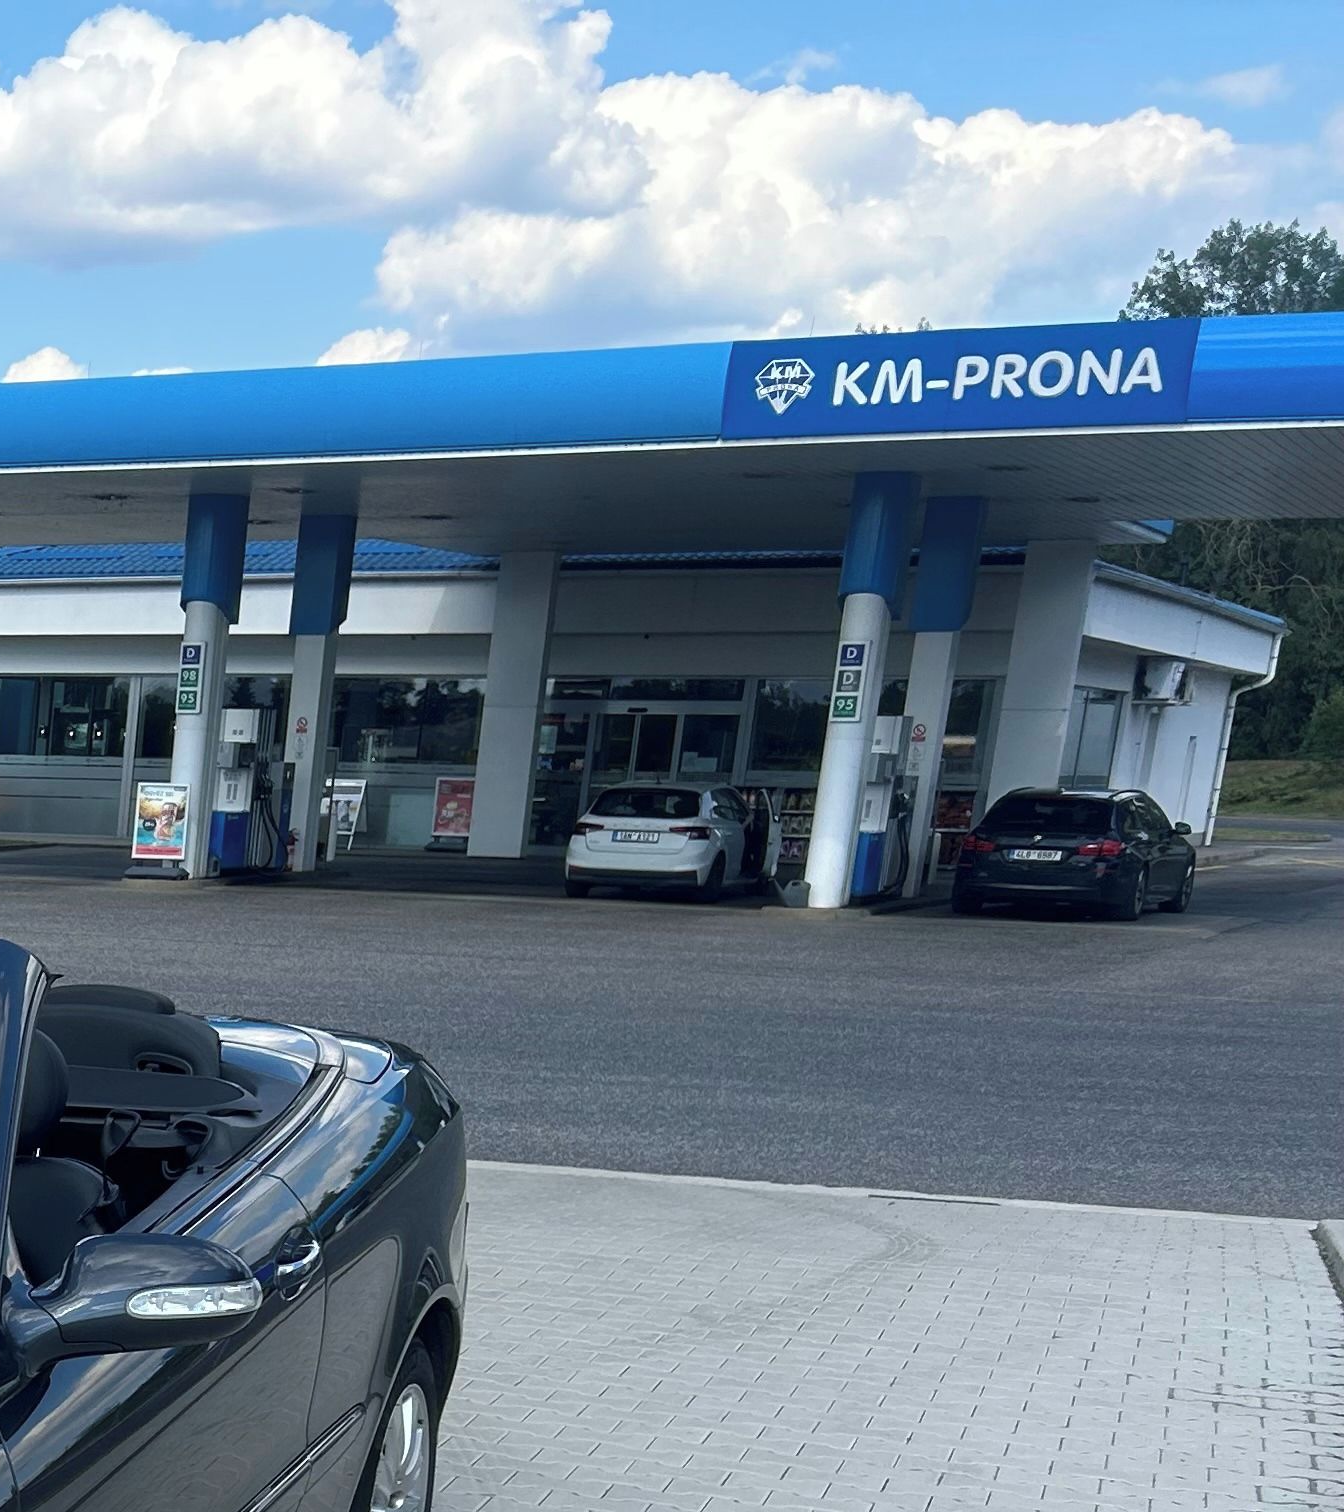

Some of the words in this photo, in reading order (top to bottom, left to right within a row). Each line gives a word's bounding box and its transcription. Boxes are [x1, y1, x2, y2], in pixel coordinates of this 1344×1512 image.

[770, 366, 802, 379] KM
[832, 347, 1163, 406] KM-PRONA
[186, 647, 196, 658] D
[846, 647, 858, 659] D
[181, 671, 197, 681] 98
[842, 672, 854, 685] D
[180, 693, 195, 704] 95
[836, 699, 854, 711] 95
